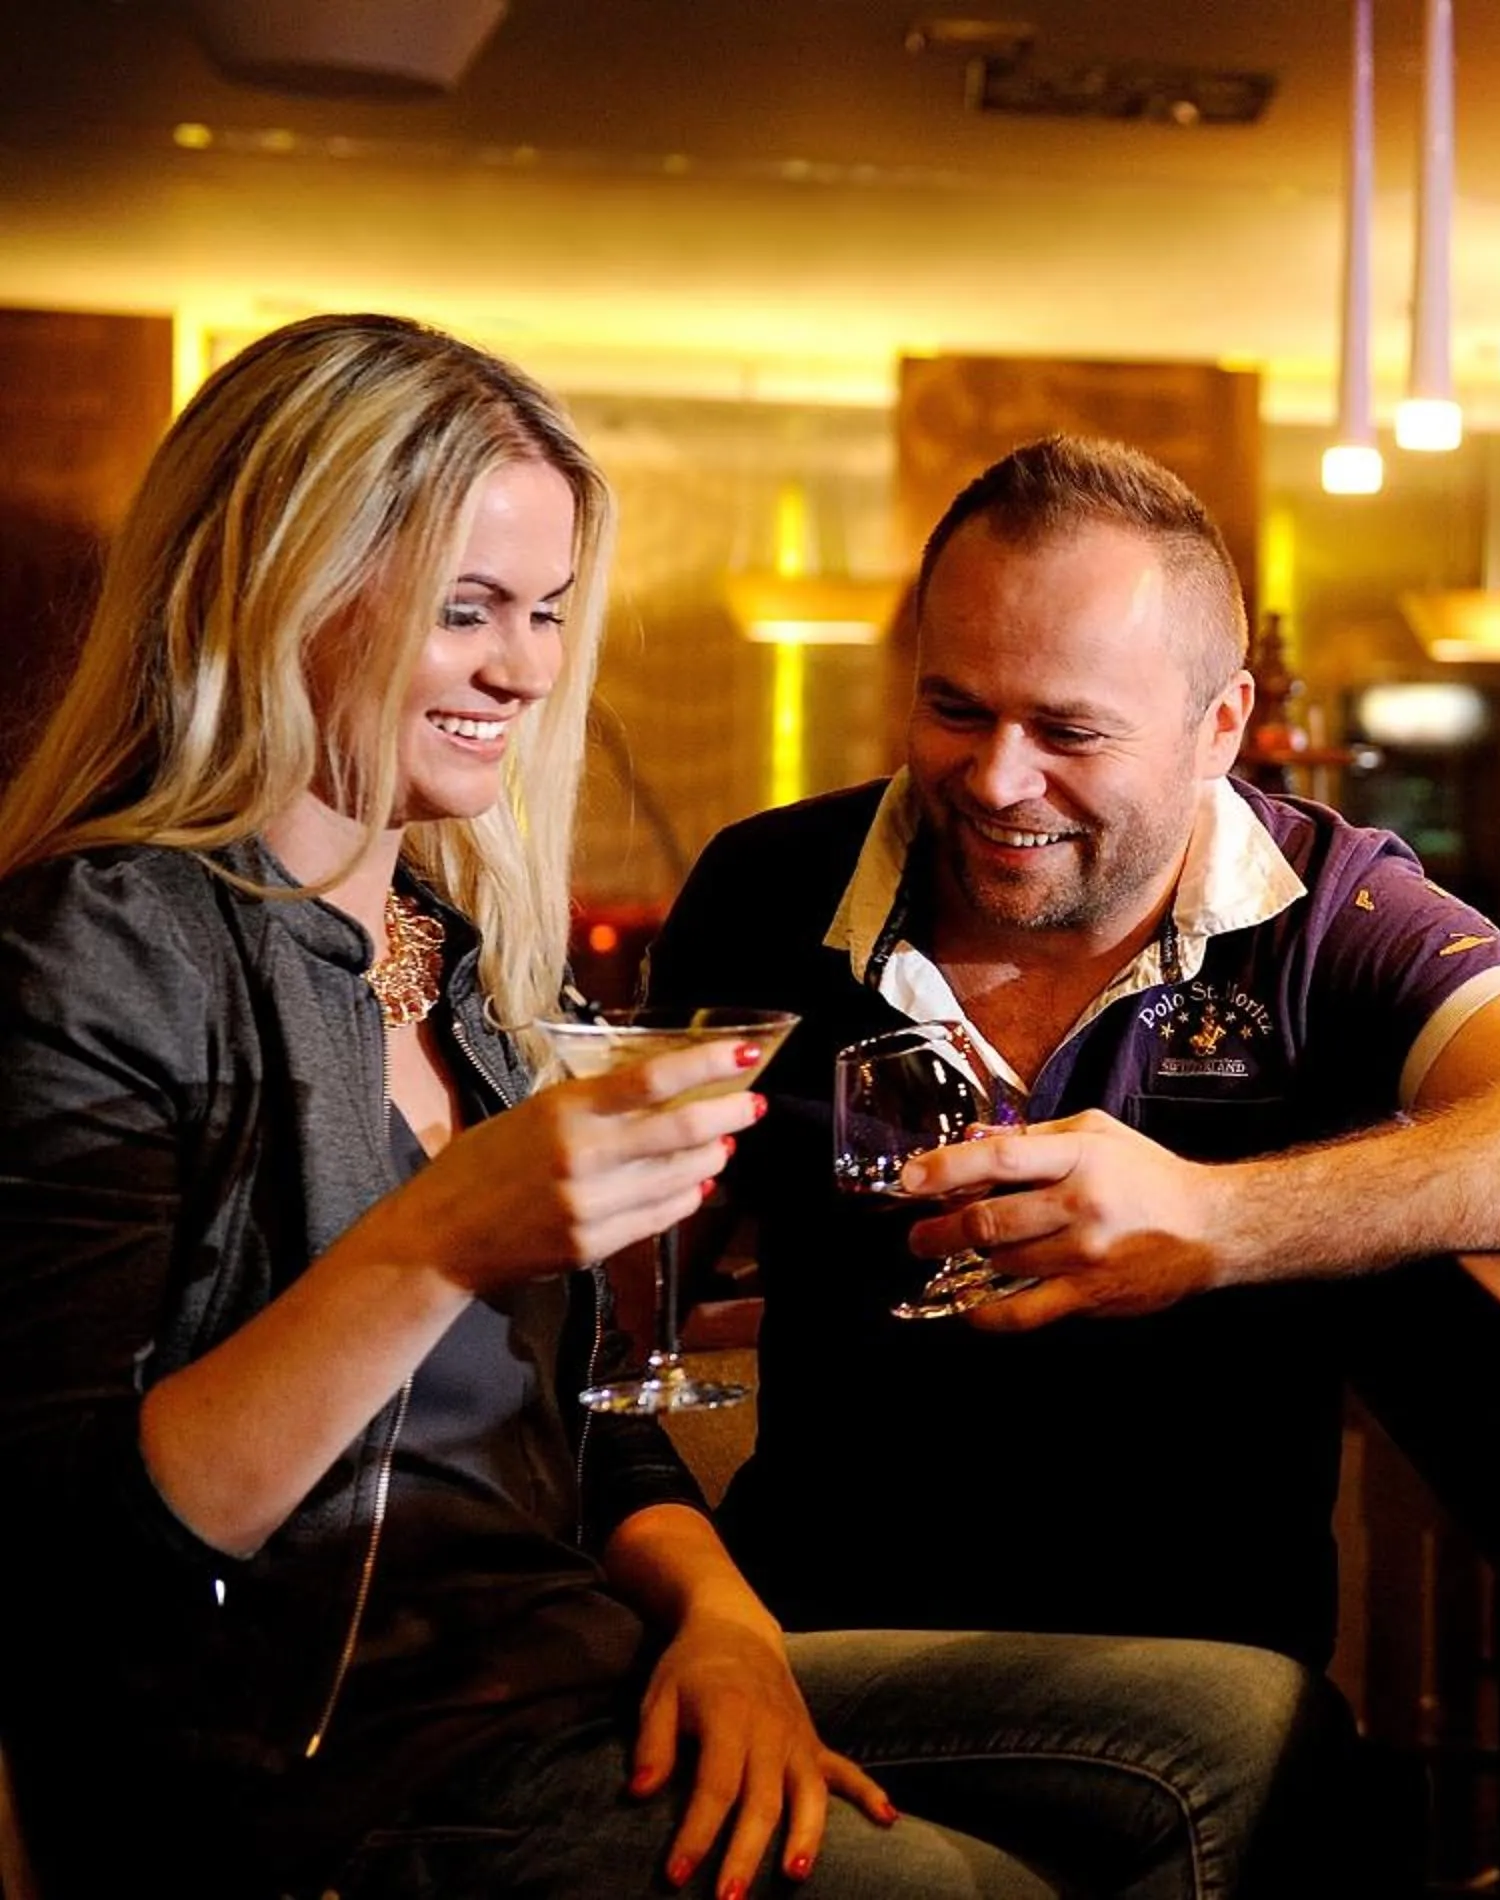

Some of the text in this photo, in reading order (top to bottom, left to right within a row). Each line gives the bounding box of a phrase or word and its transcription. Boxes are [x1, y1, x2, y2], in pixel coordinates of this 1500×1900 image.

[1138, 993, 1185, 1029] Polo
[1189, 981, 1219, 1001] St.
[1161, 1062, 1245, 1073] SWRLAND
